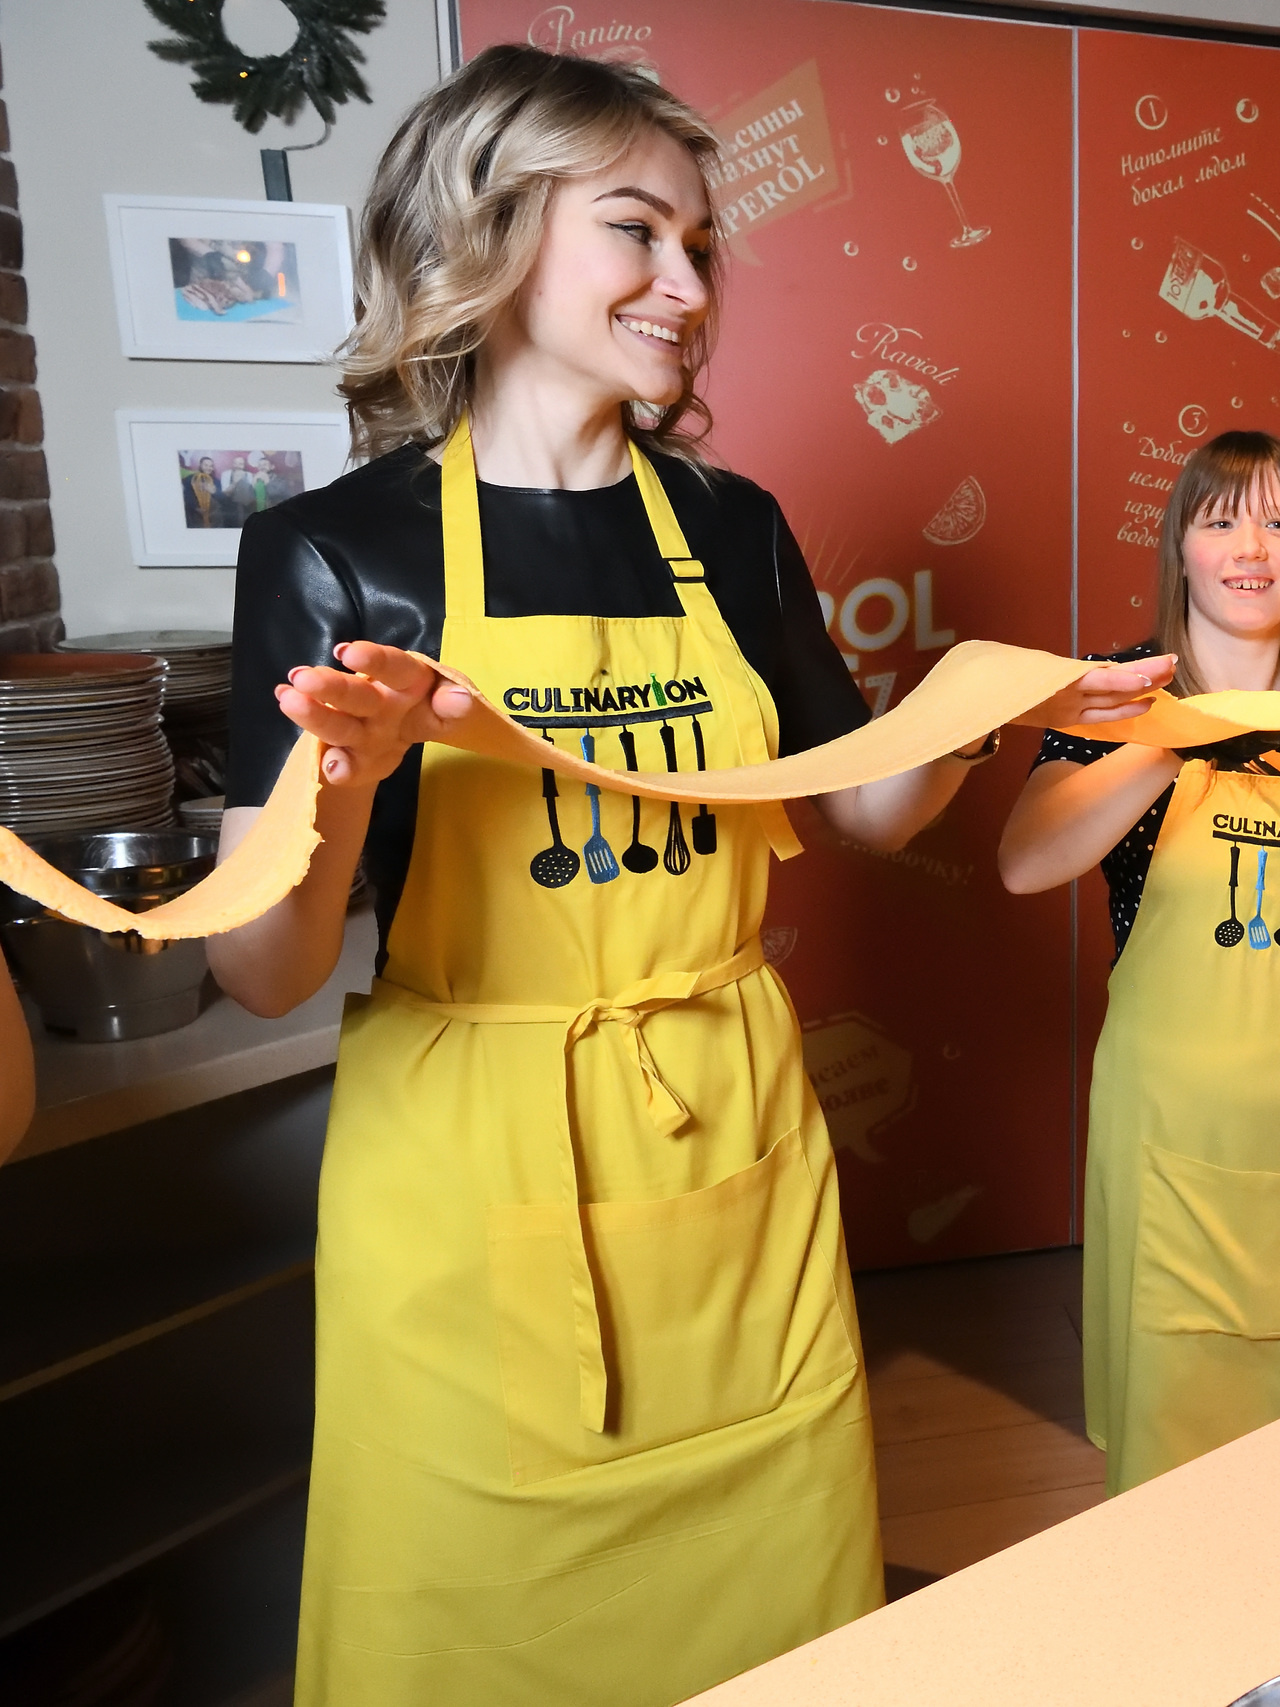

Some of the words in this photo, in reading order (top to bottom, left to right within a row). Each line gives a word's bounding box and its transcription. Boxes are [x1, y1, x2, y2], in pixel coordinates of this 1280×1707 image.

[527, 5, 653, 57] Panino
[1121, 127, 1224, 177] Наполните
[1131, 176, 1185, 206] бокал
[1195, 152, 1246, 182] льдом
[714, 155, 826, 240] PEROL
[851, 322, 960, 386] Ravioli
